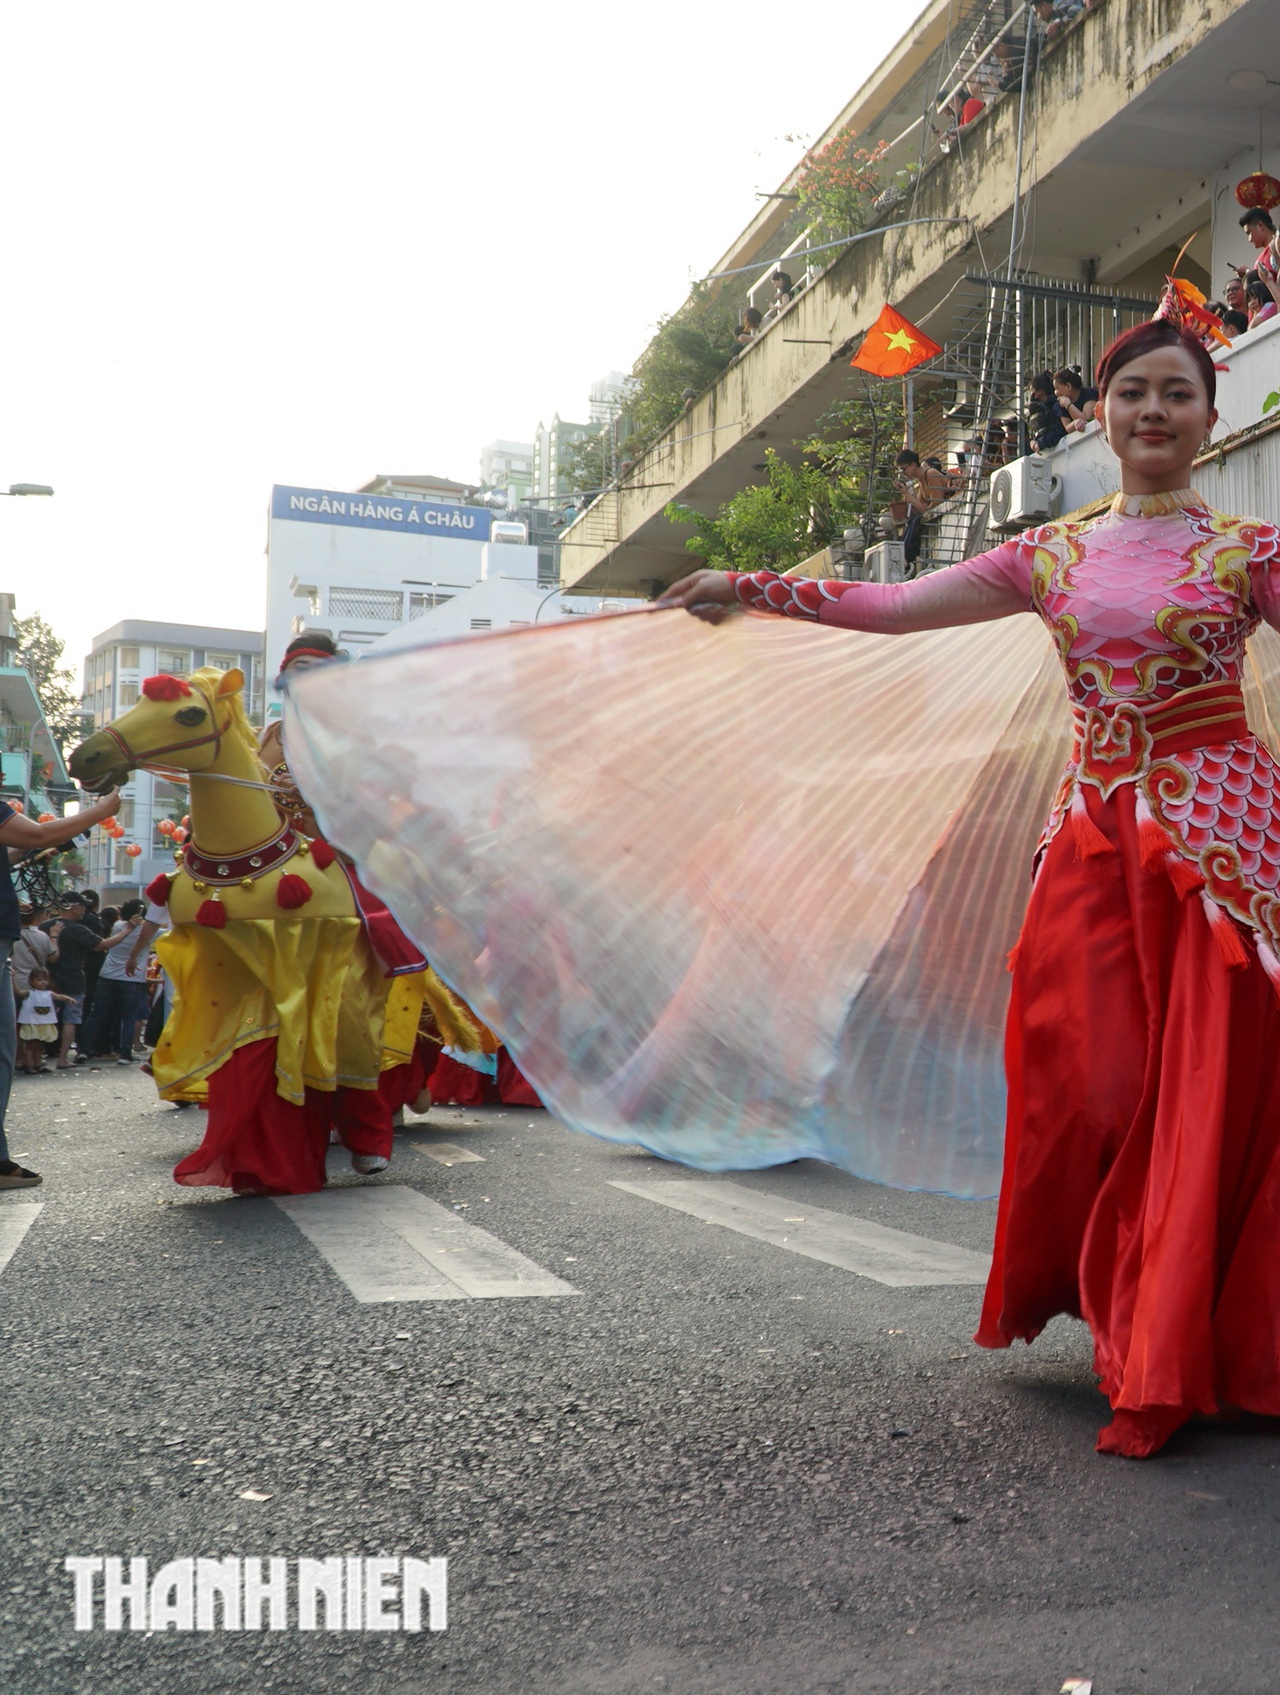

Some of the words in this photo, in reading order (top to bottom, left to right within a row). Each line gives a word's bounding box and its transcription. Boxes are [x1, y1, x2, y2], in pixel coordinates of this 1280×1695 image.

[290, 495, 345, 515] NGÂN
[350, 502, 403, 522] HÀNG
[407, 505, 420, 524] Á
[424, 510, 474, 529] CHÂU
